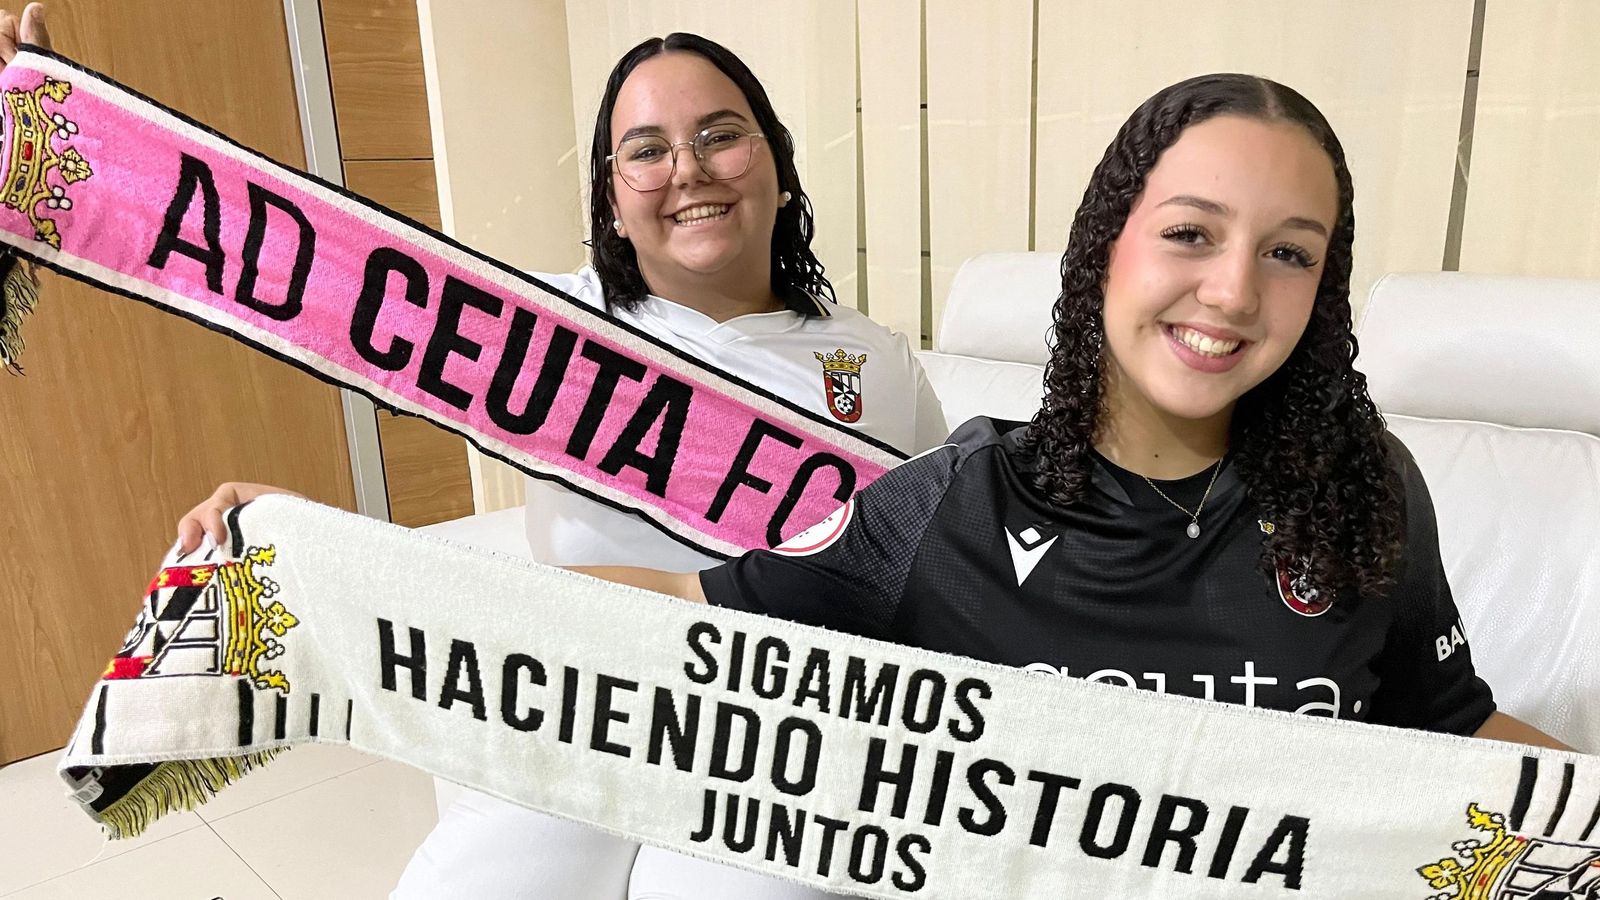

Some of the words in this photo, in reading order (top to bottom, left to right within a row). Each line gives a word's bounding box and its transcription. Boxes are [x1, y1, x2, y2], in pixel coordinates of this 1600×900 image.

[147, 153, 316, 321] AD
[350, 247, 693, 498] CEUTA
[704, 418, 856, 549] FC
[684, 622, 992, 742] SIGAMOS
[1436, 617, 1467, 661] BA
[378, 618, 822, 796] HACIENDO
[858, 738, 1309, 890] HISTORIA
[690, 789, 931, 892] JUNTOS
